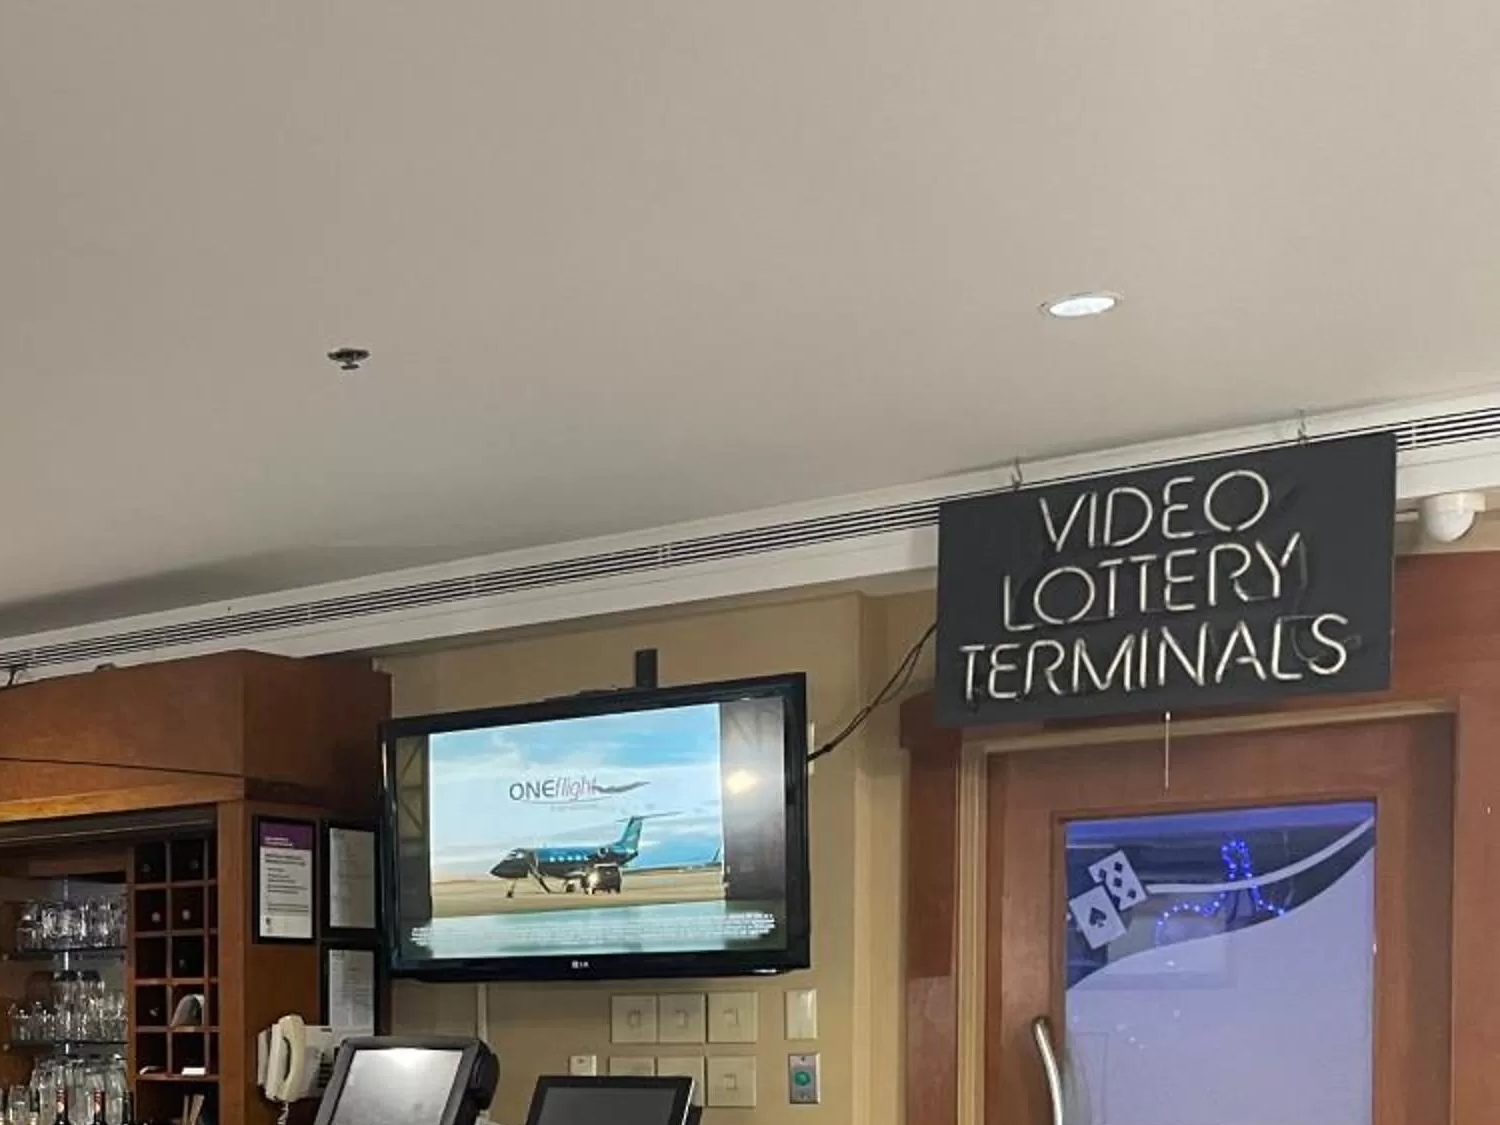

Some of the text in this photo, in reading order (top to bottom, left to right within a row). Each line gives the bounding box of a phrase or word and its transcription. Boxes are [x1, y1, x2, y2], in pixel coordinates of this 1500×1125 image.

[1040, 470, 1270, 552] VIDEO
[1004, 532, 1301, 632] LOTTERY
[960, 614, 1349, 700] TERMINALS
